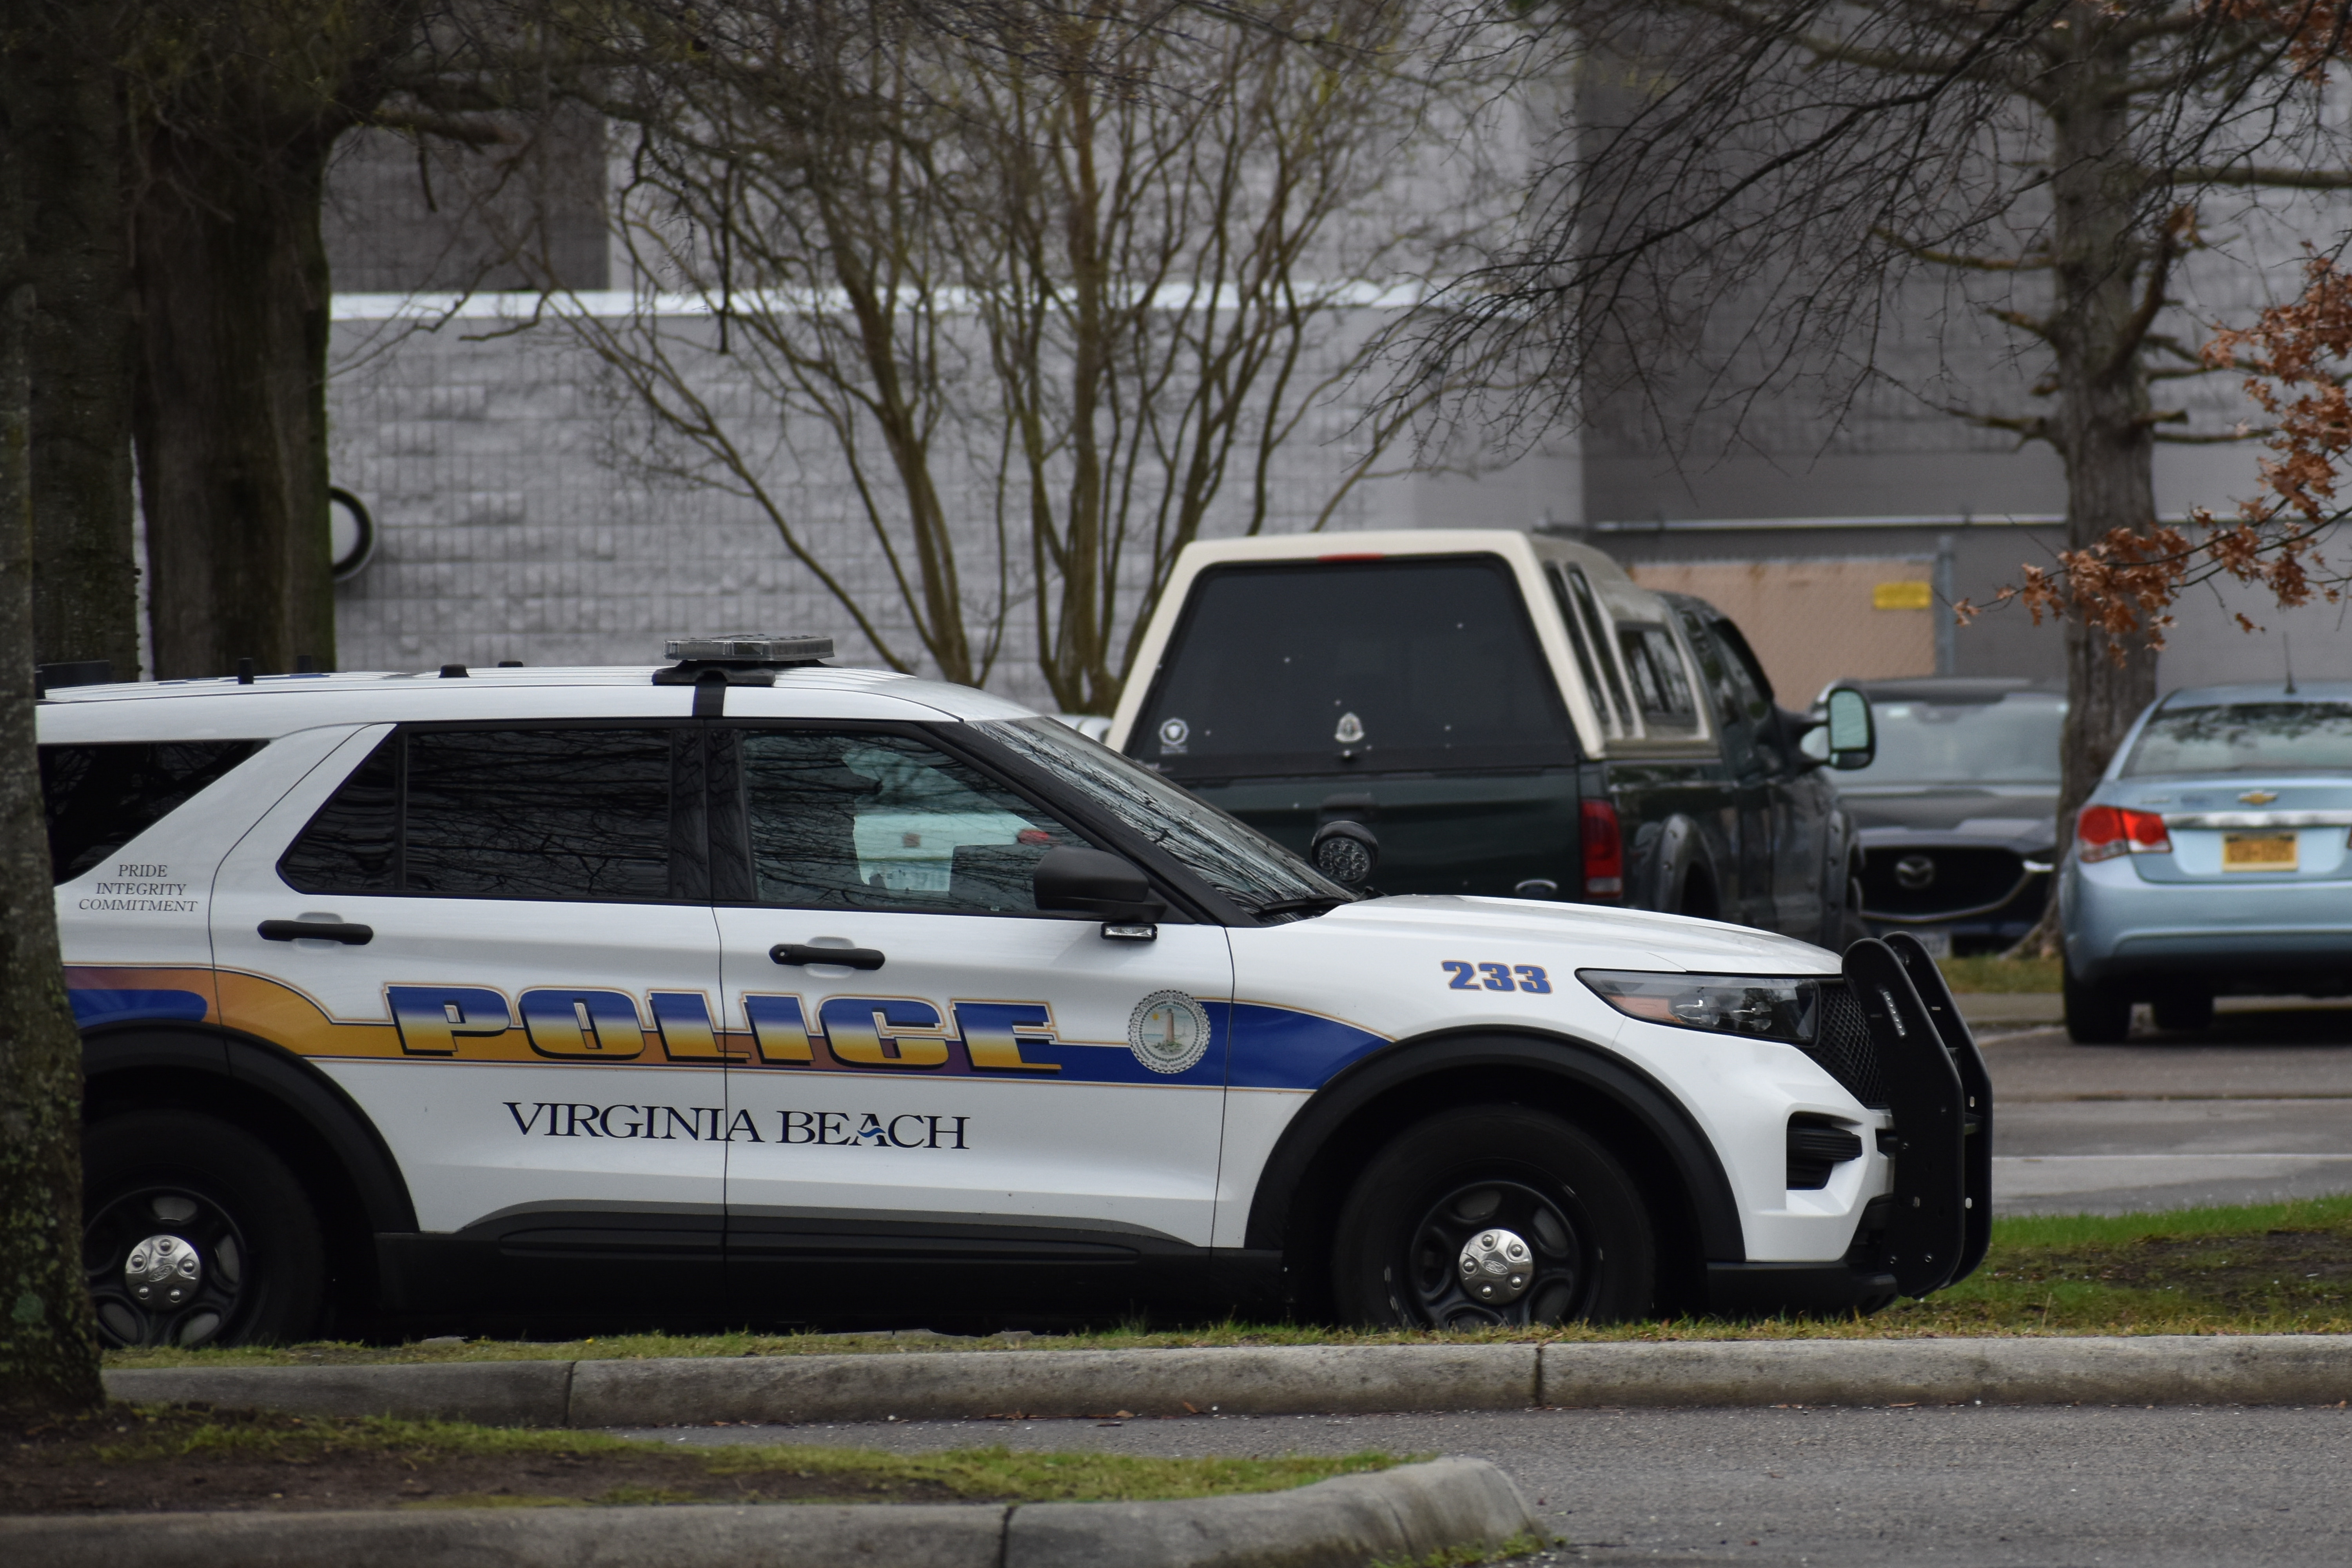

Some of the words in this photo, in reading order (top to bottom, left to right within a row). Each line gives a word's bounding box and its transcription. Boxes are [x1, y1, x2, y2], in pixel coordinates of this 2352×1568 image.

[118, 864, 168, 877] PRIDE
[96, 882, 187, 895] INTEGRITY
[79, 899, 198, 912] COMMITMENT
[1441, 960, 1553, 994] 233
[386, 985, 1062, 1074] POLICE
[502, 1102, 765, 1143] VIRGINIA
[775, 1110, 970, 1149] BEACH
